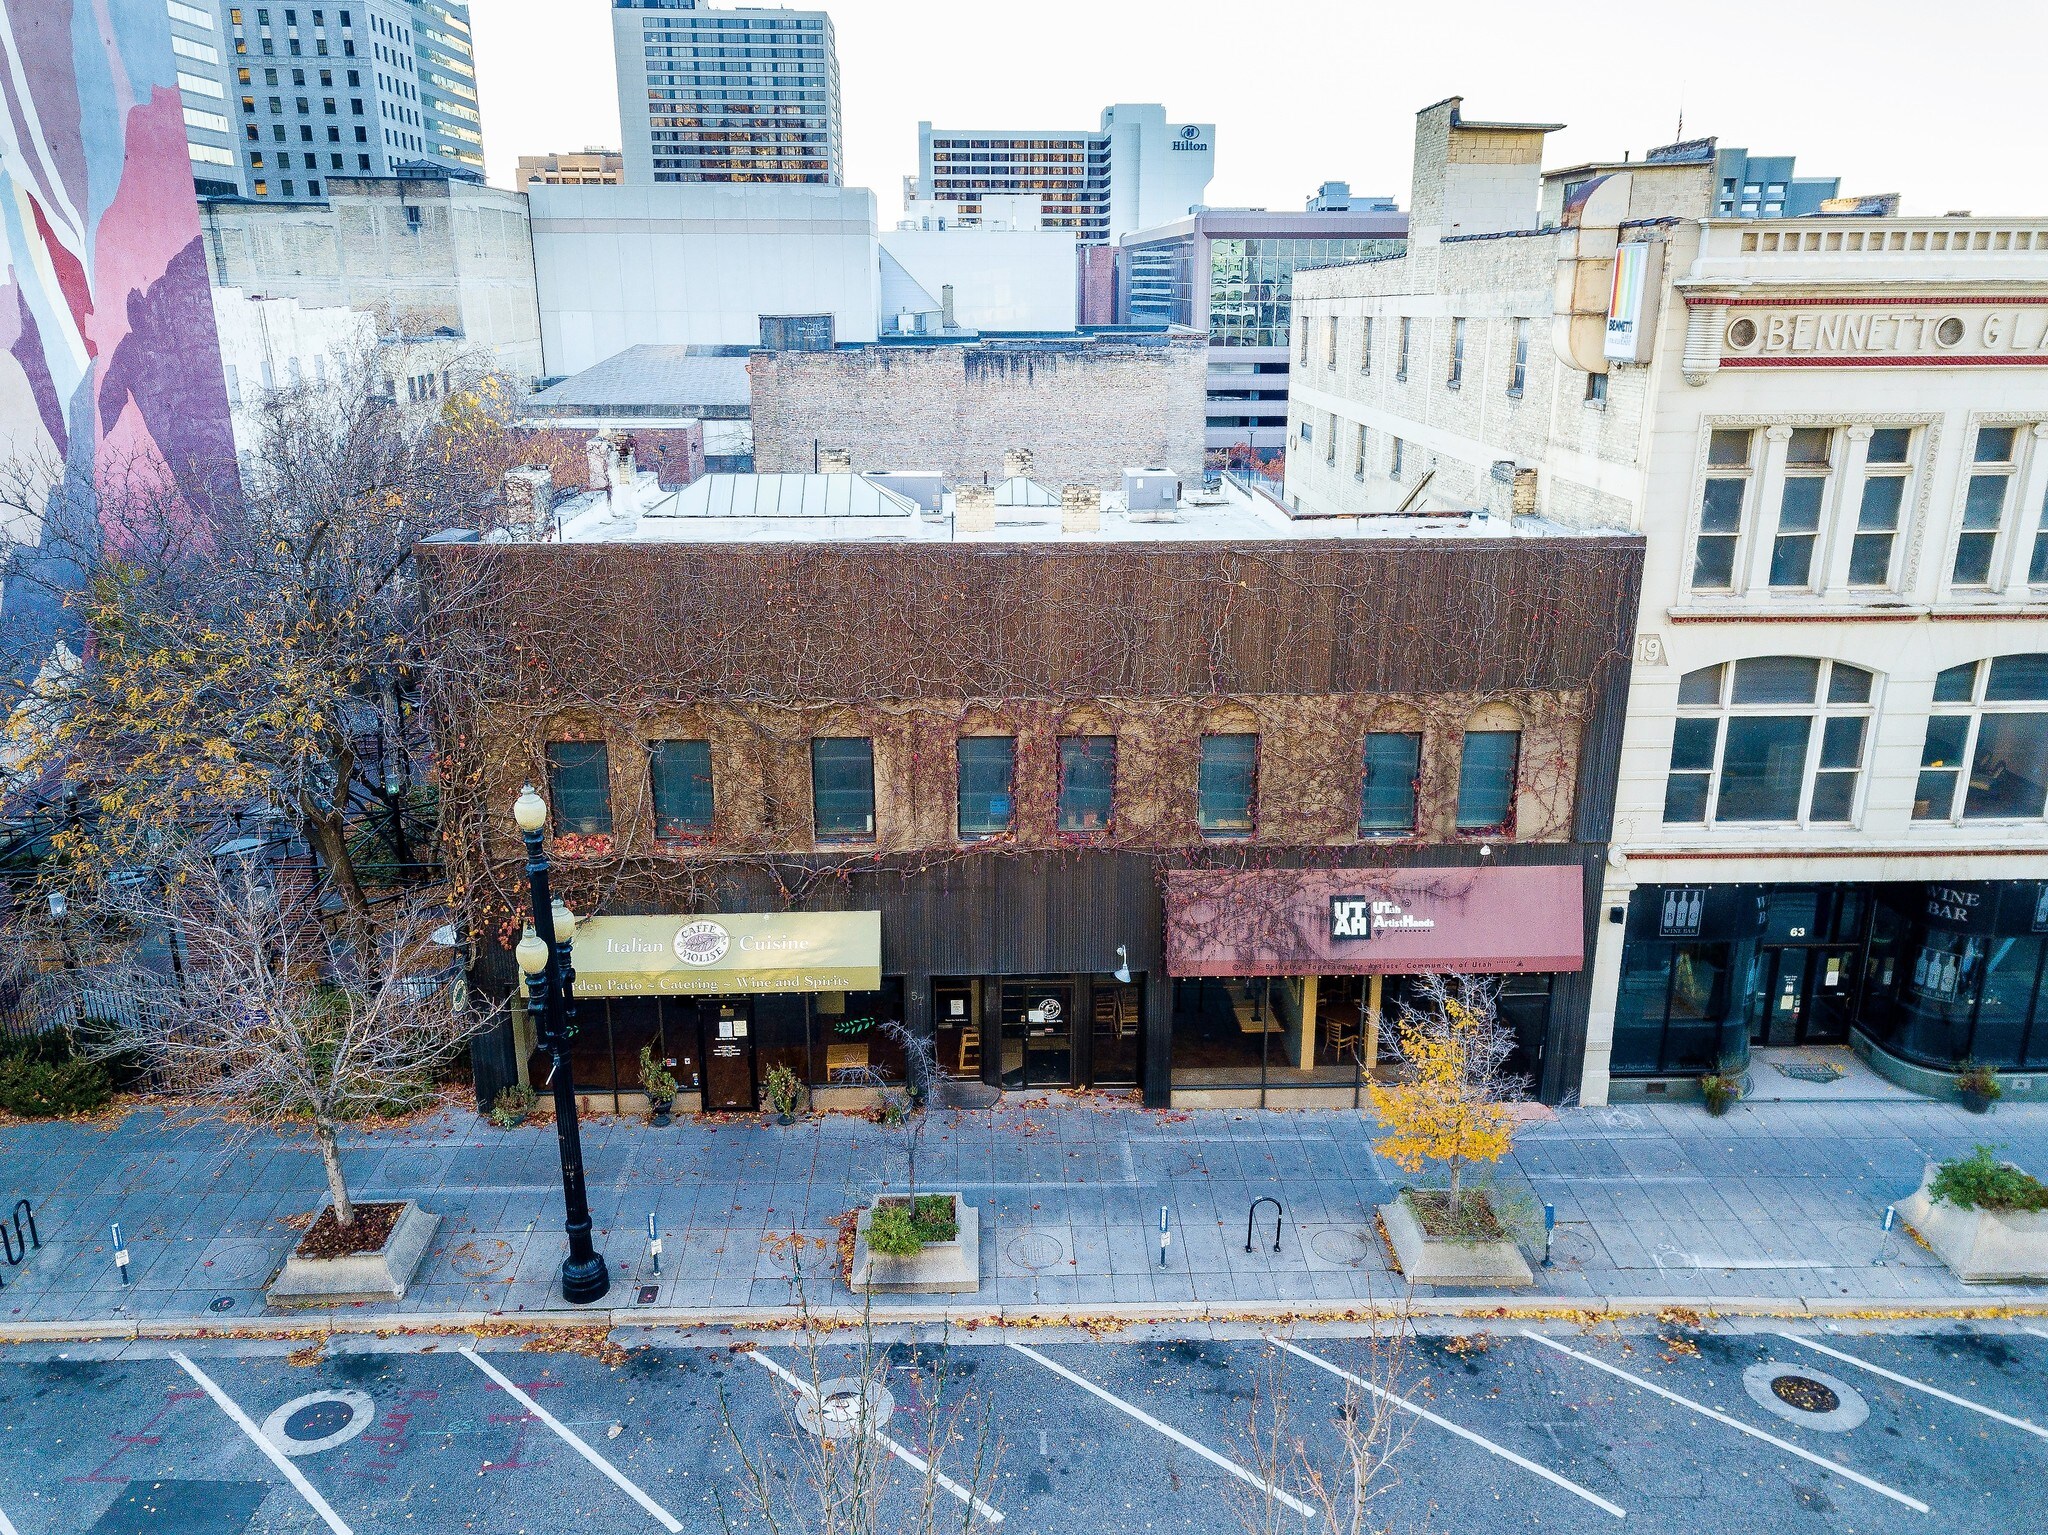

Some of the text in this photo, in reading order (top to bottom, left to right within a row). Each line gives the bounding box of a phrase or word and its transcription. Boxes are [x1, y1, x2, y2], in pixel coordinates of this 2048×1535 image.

[1172, 140, 1208, 151] Hilton
[1765, 313, 1938, 351] BENNETT
[1639, 639, 1661, 661] 19
[1927, 885, 1980, 907] WINE
[1372, 901, 1402, 914] UTah
[1927, 900, 1968, 921] BAR
[1373, 915, 1435, 928] ArtistHands
[681, 924, 717, 939] CAFFE
[1790, 927, 1806, 937] 63
[606, 934, 809, 953] Italian Cuisine
[680, 946, 724, 963] MOLISE
[1406, 962, 1454, 970] Community
[1458, 961, 1468, 969] of
[571, 980, 602, 991] rden
[607, 979, 642, 990] Patio
[660, 978, 719, 992] Catering
[736, 976, 772, 988] Wine
[775, 975, 800, 987] and
[804, 975, 849, 989] Spirits
